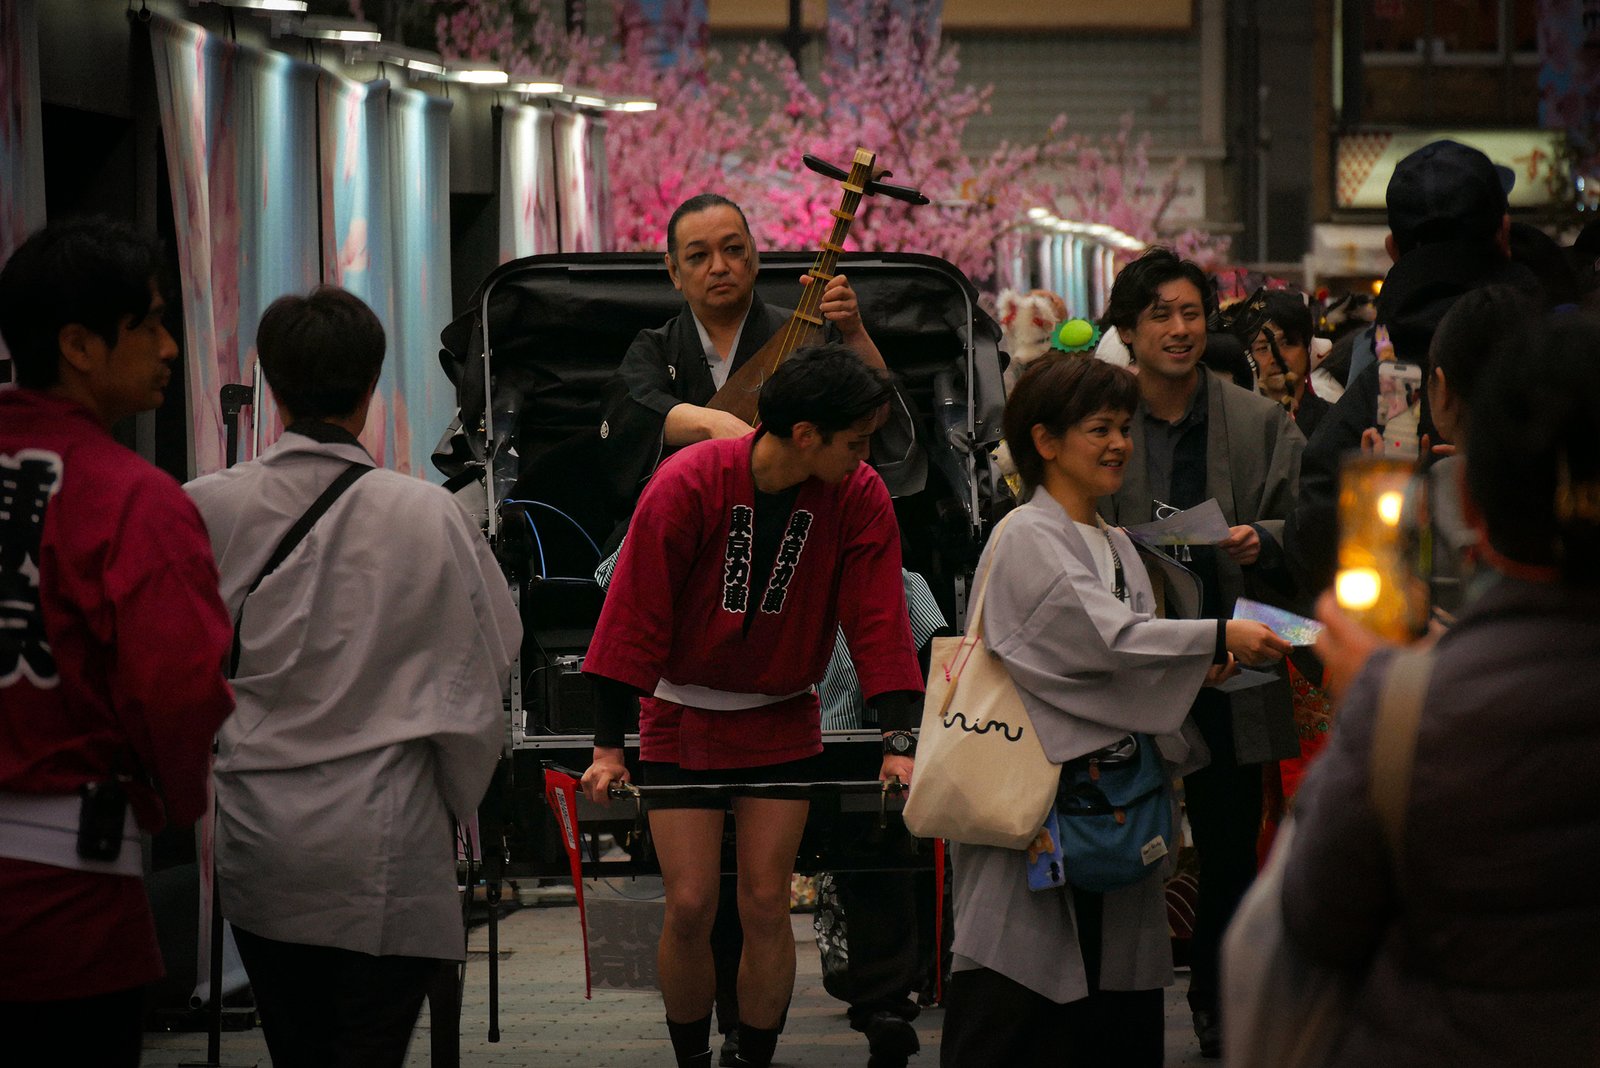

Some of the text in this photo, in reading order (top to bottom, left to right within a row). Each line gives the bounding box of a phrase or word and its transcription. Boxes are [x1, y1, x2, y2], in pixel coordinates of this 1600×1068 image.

[723, 504, 754, 613] 東京力車
[760, 509, 814, 614] 東京力車
